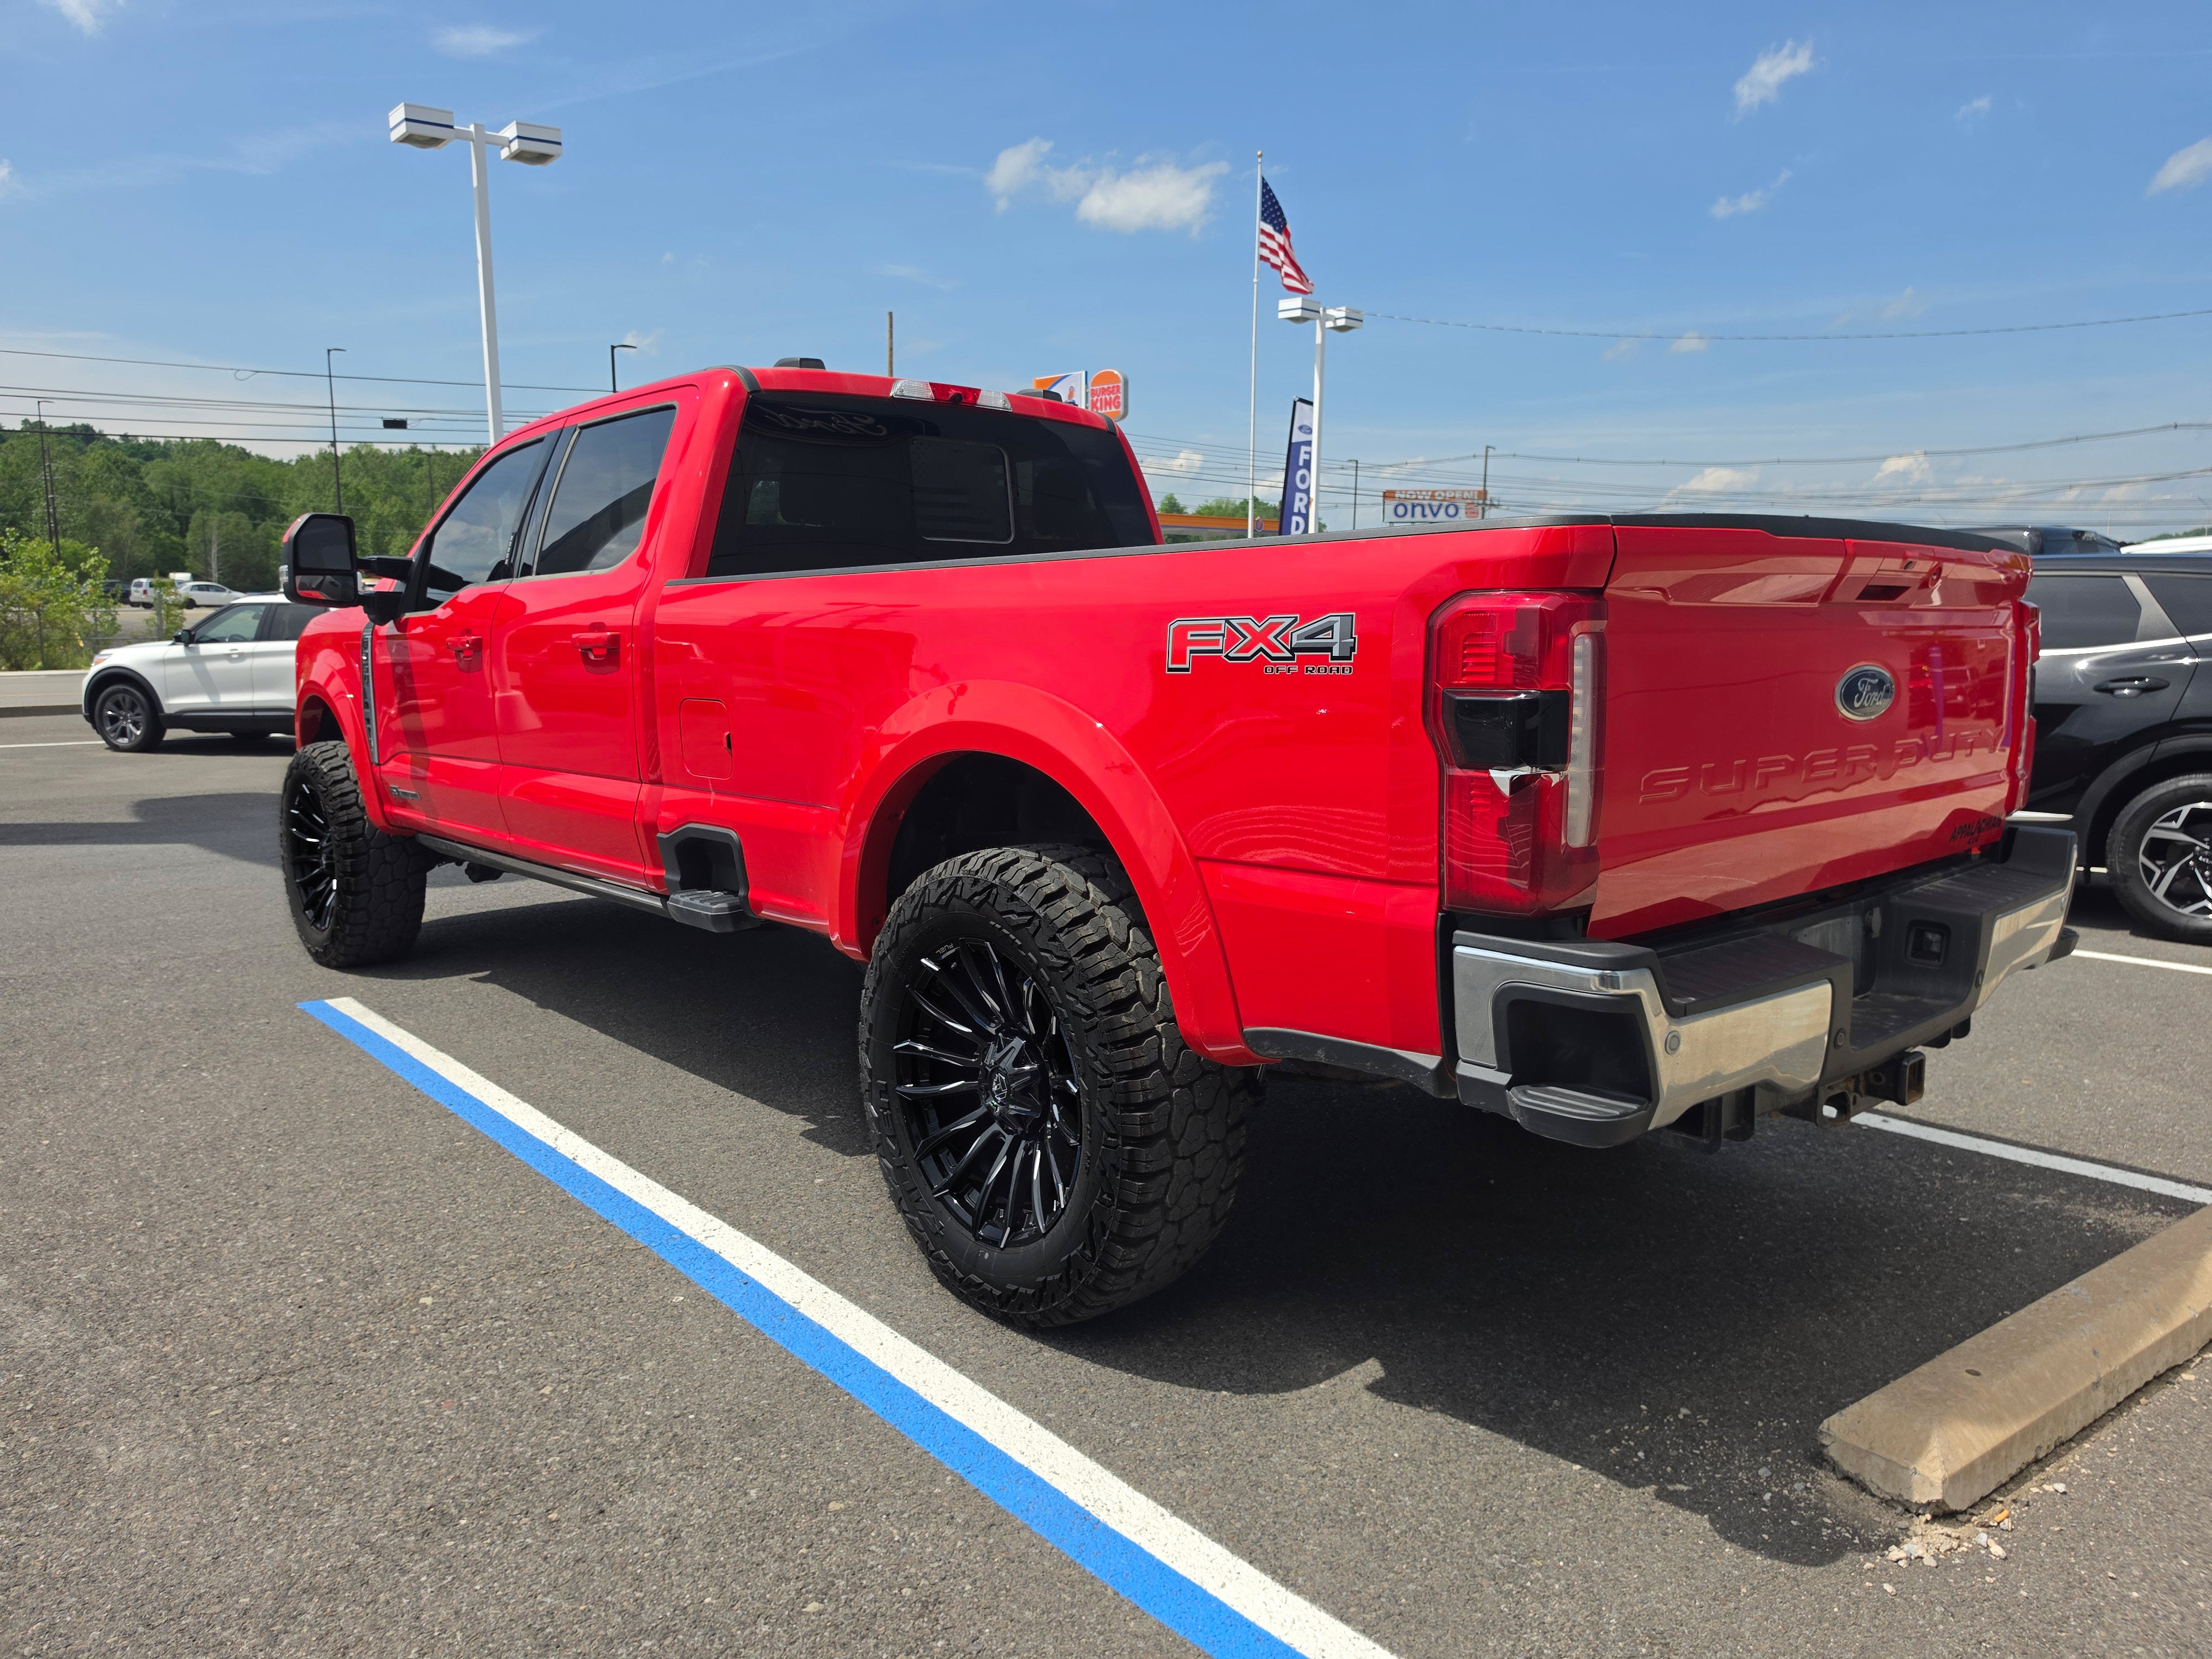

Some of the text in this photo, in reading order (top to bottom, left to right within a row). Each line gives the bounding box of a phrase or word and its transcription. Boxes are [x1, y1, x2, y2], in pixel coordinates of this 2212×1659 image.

[1091, 384, 1120, 398] BURGER
[1091, 395, 1120, 412] KING
[1291, 445, 1311, 535] FORD
[1395, 491, 1478, 500] NOW OPEN!
[1394, 502, 1459, 518] onvo
[1166, 612, 1357, 674] FX4
[1264, 665, 1354, 675] OFF ROAD
[1854, 678, 1886, 708] Ford
[1639, 728, 2006, 805] SUPER DUTY
[935, 943, 954, 954] FUEL
